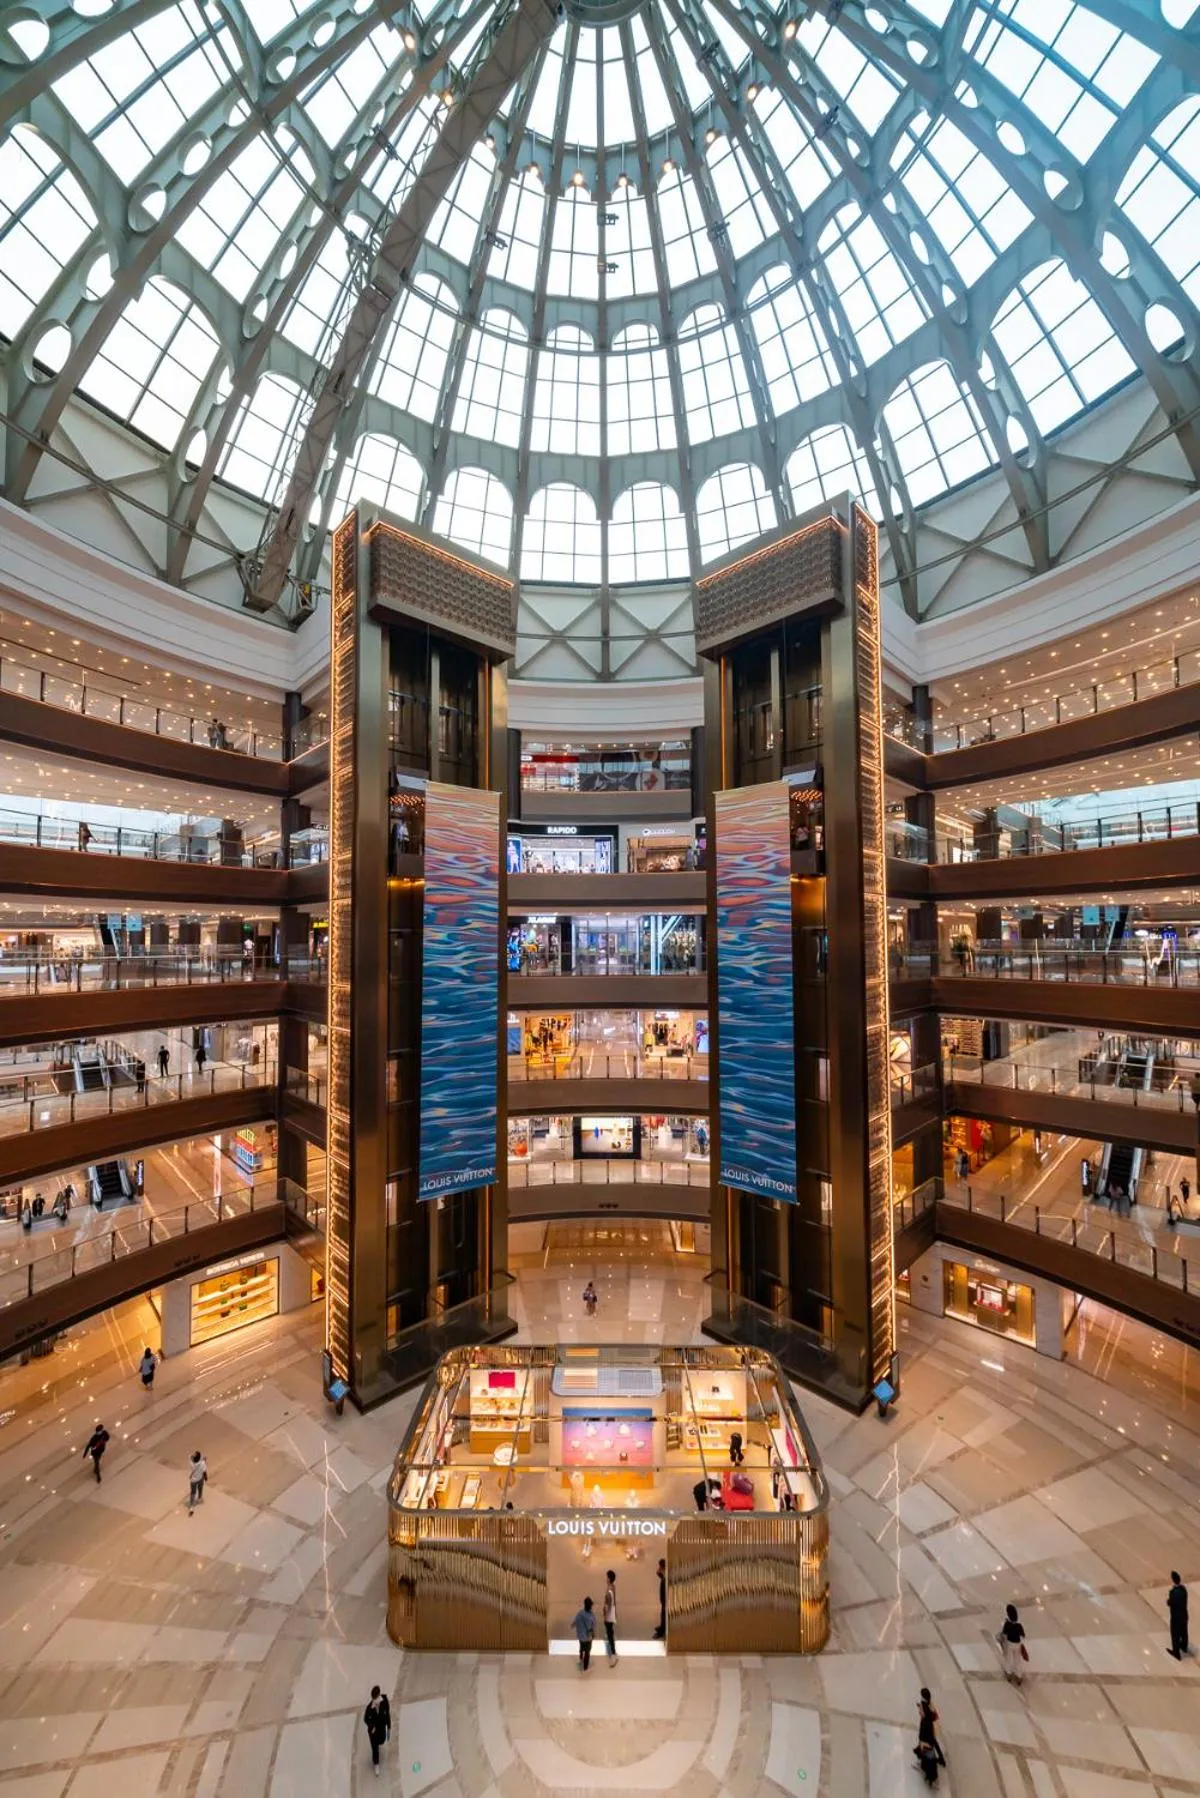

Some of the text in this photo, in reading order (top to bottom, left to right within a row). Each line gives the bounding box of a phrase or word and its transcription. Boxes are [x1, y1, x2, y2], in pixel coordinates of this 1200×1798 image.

[423, 1167, 493, 1191] LOUIS VUITTON
[723, 1168, 794, 1194] LOUIS VUITTON
[548, 1520, 666, 1535] LOUIS VUITTON
